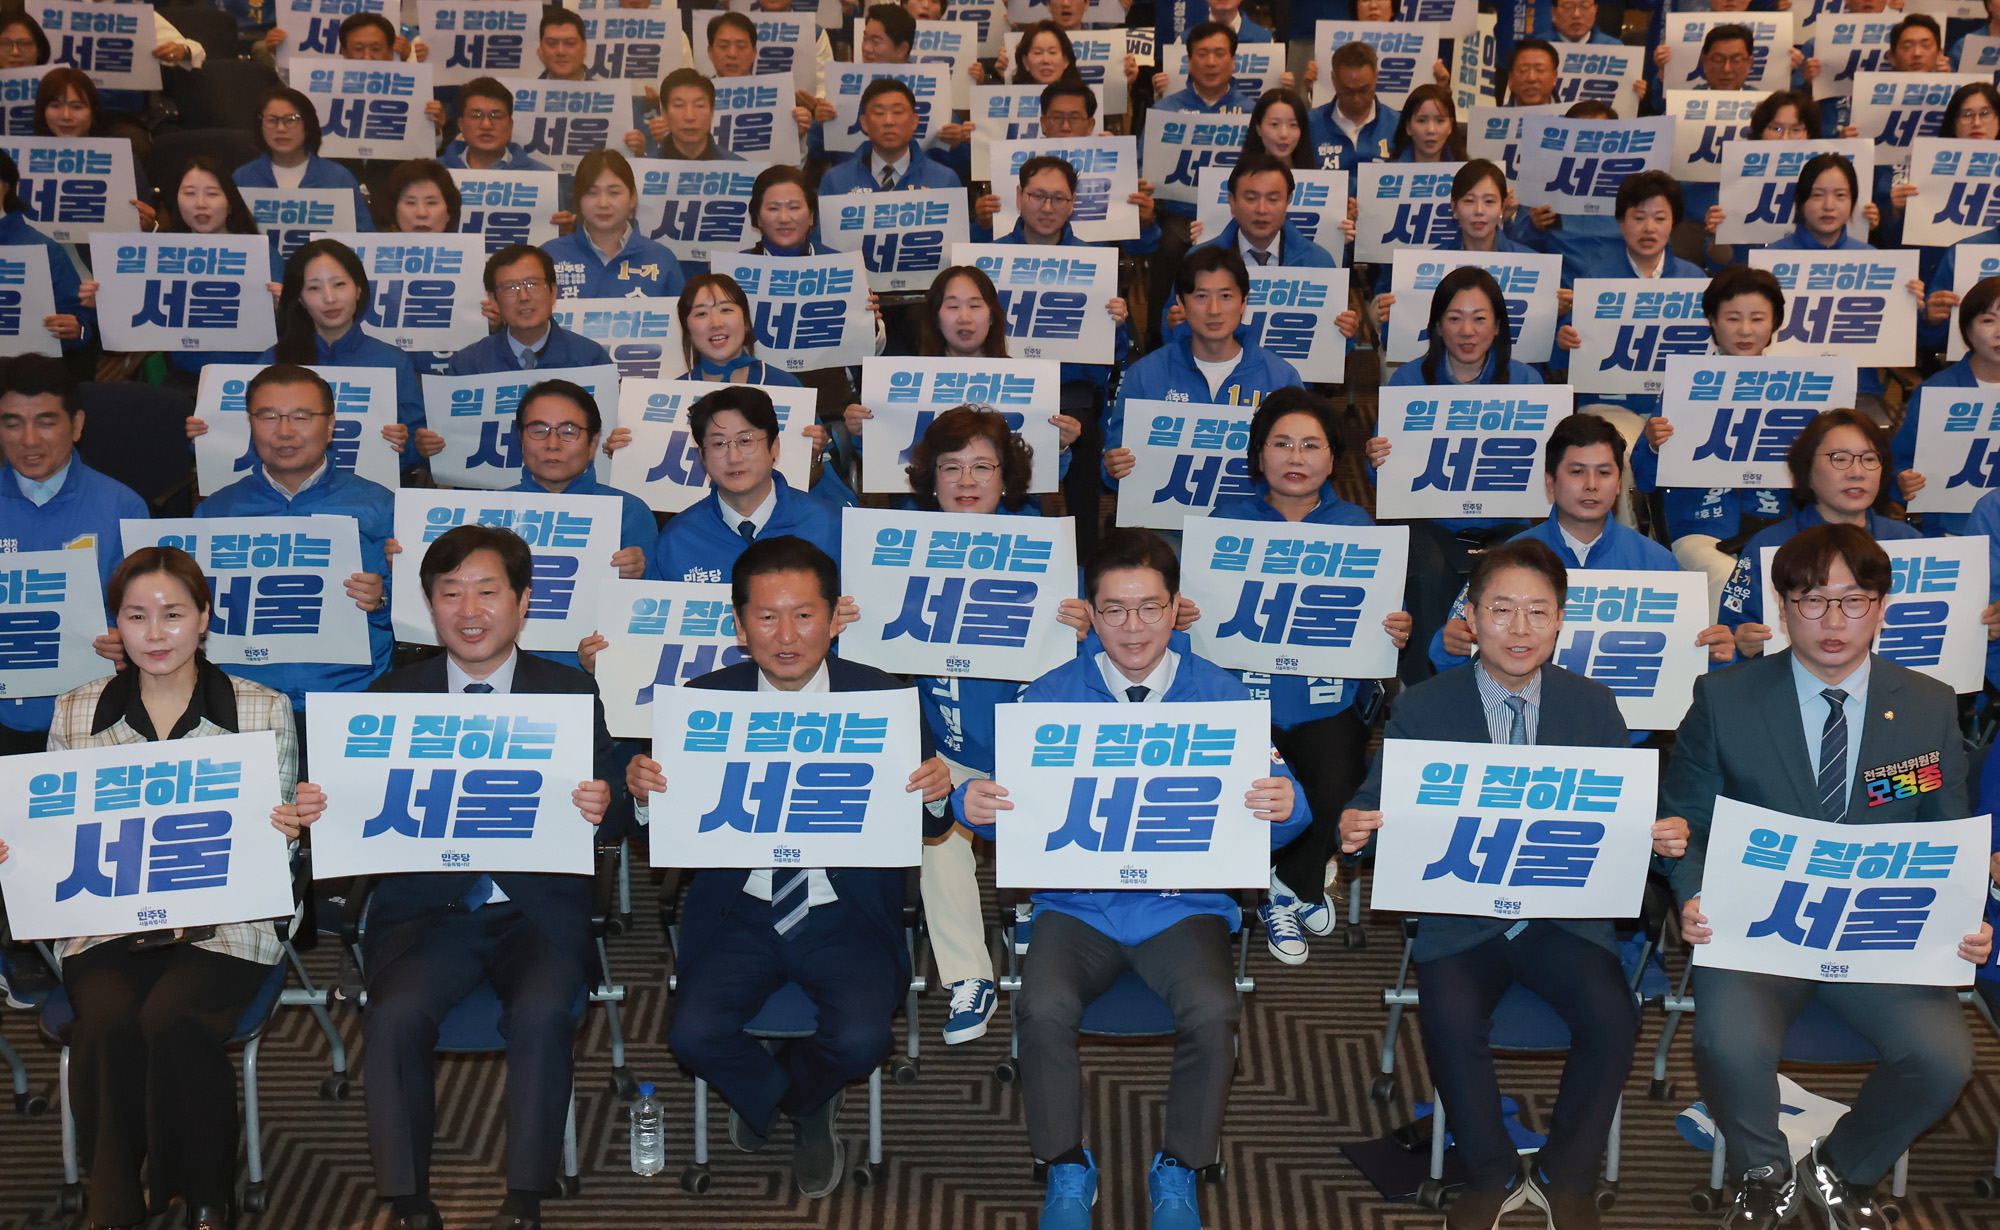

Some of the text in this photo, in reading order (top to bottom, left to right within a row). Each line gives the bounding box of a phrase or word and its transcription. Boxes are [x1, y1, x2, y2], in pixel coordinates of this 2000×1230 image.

[42, 9, 137, 34] 일 잘하는
[435, 10, 527, 30] 일 잘하는
[604, 19, 665, 39] 잘하는
[757, 23, 800, 43] 하는
[1683, 23, 1705, 42] 일
[1832, 24, 1856, 44] 일
[54, 35, 134, 73] 서울
[446, 35, 523, 69] 서울
[589, 44, 661, 78] 서울
[1563, 54, 1628, 76] 잘하는
[309, 70, 415, 96] 일 잘하는
[840, 74, 863, 95] 일
[1871, 83, 1955, 106] 일 잘하
[513, 89, 614, 113] 일 잘하는
[988, 96, 1011, 118] 일
[1684, 100, 1708, 120] 일
[321, 99, 409, 140] 서울
[1485, 118, 1510, 139] 일
[524, 117, 609, 155] 서울
[1161, 123, 1249, 147] 일 잘하
[1378, 139, 1390, 158] 1
[1540, 127, 1655, 153] 일 잘하는
[29, 149, 112, 174] 잘하는
[1741, 153, 1769, 177] 일
[1931, 151, 1962, 175] 일
[642, 171, 754, 197] 일 잘하는
[1376, 175, 1404, 198] 일
[1545, 157, 1645, 197] 서울
[460, 181, 539, 207] 잘하는
[254, 199, 334, 225] 잘하는
[651, 201, 747, 242] 서울
[840, 201, 949, 230] 일 잘하는
[117, 246, 246, 275] 일 잘하는
[374, 246, 463, 273] 잘하는
[862, 231, 943, 272] 서울
[734, 267, 853, 296] 일 잘하는
[976, 257, 1096, 285] 일 잘하는
[1414, 263, 1445, 291] 일
[1772, 263, 1896, 290] 일 잘하는
[132, 280, 240, 328] 서울
[1248, 279, 1329, 308] 잘하는
[1595, 292, 1626, 319] 일
[582, 311, 670, 338] 잘하는
[755, 301, 847, 350] 서울
[1004, 291, 1087, 340] 서울
[1778, 297, 1886, 344] 서울
[1600, 325, 1712, 372] 서울
[888, 372, 1035, 406] 일 잘하는
[1689, 371, 1833, 401] 일 잘하는
[451, 389, 484, 416] 일
[643, 394, 681, 423] 일
[1403, 400, 1548, 431] 일 잘하는
[1147, 416, 1185, 447] 일
[1944, 403, 1983, 432] 일
[1693, 408, 1818, 462] 서울
[1411, 438, 1537, 492] 서울
[1742, 472, 1762, 480] 민주당
[1463, 503, 1482, 511] 민주당
[1700, 506, 1723, 519] 후보
[0, 537, 18, 553] 청장
[211, 534, 331, 569] 잘하는
[872, 529, 1052, 573] 일 잘하는
[1210, 536, 1381, 578] 일 잘하는
[684, 569, 722, 583] 민주당
[1738, 556, 1752, 571] 민주
[1890, 557, 1960, 594] 하는
[628, 598, 671, 635] 일
[881, 576, 1038, 647] 서울
[1216, 580, 1365, 647] 서울
[1564, 586, 1679, 623] 잘하는
[1880, 600, 1950, 669] 울
[244, 648, 269, 657] 민주당
[946, 658, 971, 668] 민주당
[1275, 657, 1299, 667] 민주당
[344, 715, 554, 759] 일 잘하는
[684, 711, 888, 753] 일 잘하는
[1032, 723, 1236, 766] 일 잘하는
[1863, 750, 1941, 782] 전국청년위원장
[29, 759, 241, 819] 일 잘하는
[698, 762, 874, 833] 서울
[1416, 763, 1624, 812] 일 잘하는
[1866, 763, 1944, 808] 모경종
[363, 769, 542, 838] 서울
[1045, 777, 1222, 852] 서울
[55, 810, 234, 903] 서울
[441, 853, 470, 863] 민주당
[773, 848, 801, 858] 민주당
[1422, 817, 1605, 887] 서울
[1742, 829, 1958, 879] 일 잘하는
[1120, 868, 1148, 879] 민주당
[137, 909, 167, 921] 민주당
[1494, 899, 1522, 910] 민주당
[1746, 881, 1936, 951] 서울
[1820, 963, 1849, 974] 민주당
